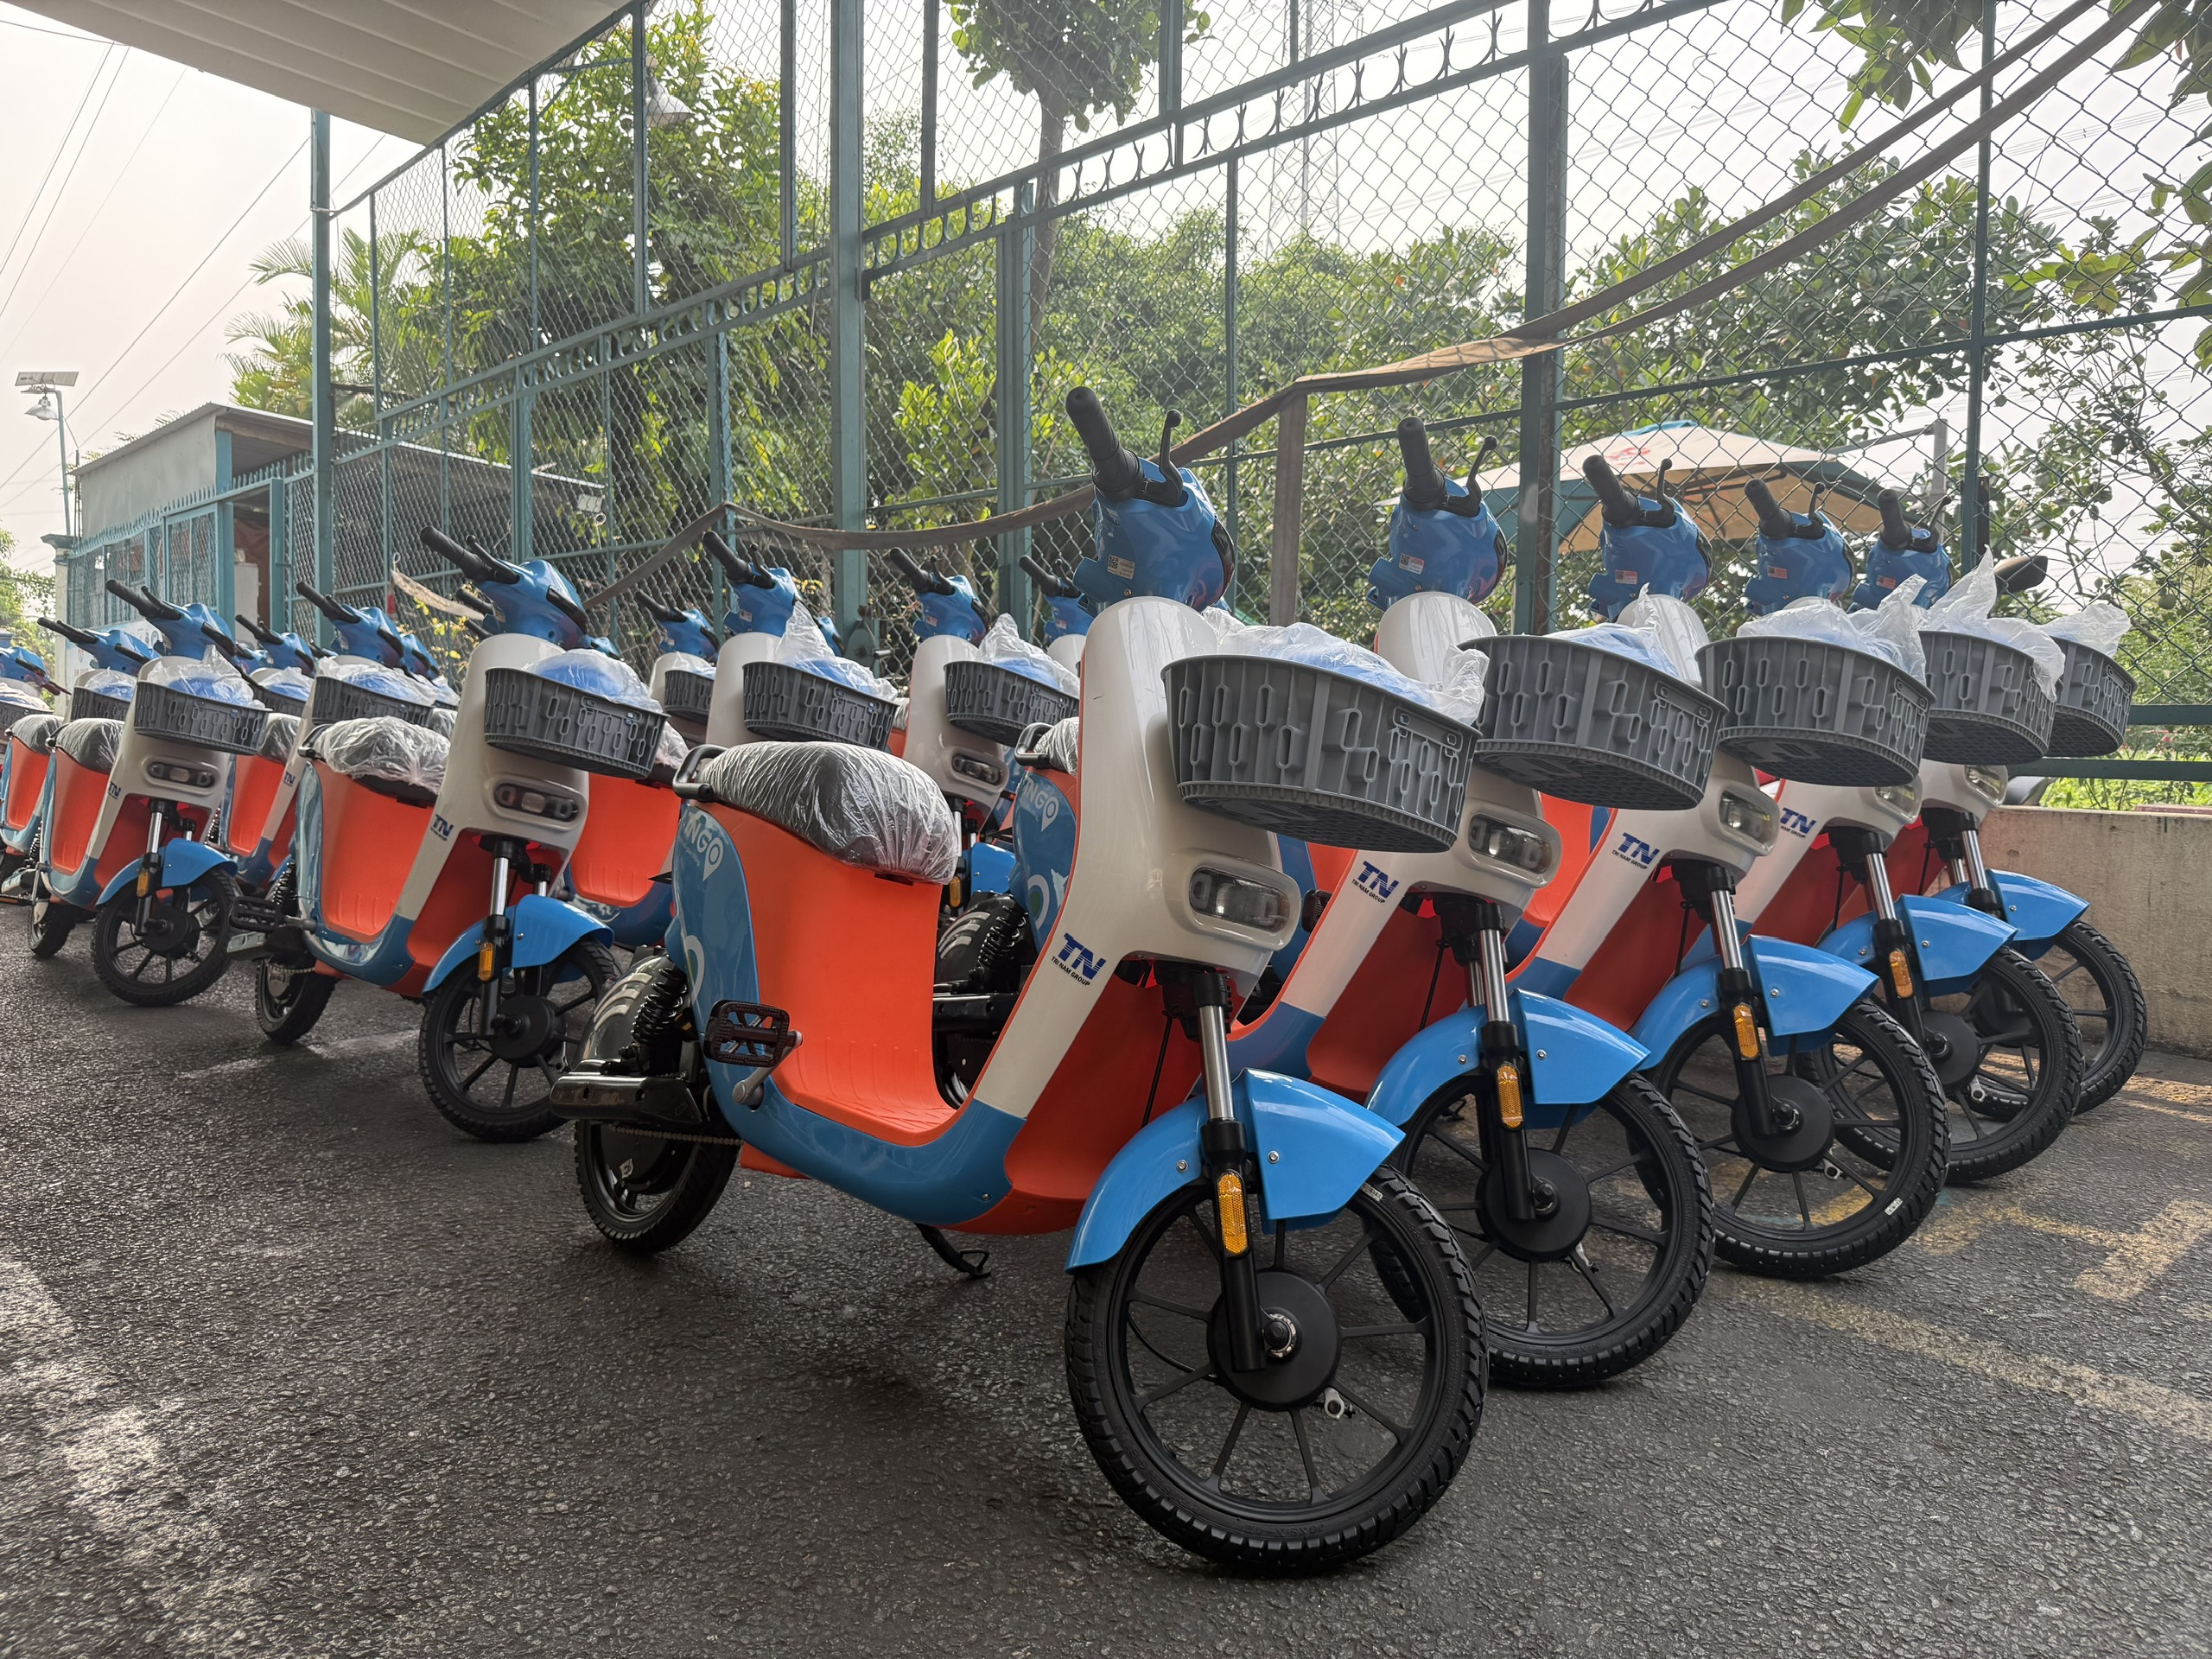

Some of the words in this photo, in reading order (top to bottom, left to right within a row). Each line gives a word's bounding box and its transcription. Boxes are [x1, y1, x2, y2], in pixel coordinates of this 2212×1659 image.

[433, 814, 454, 836] TN
[1780, 807, 1816, 834] TN
[1618, 832, 1660, 865] TN
[1619, 853, 1631, 861] NAM
[1630, 859, 1648, 869] GROUP
[1357, 861, 1400, 899] TN
[1358, 884, 1370, 894] NAM
[1369, 892, 1386, 904] GROUP
[1058, 932, 1106, 980] TN
[1052, 956, 1060, 965] TRI
[1059, 962, 1071, 975] NAM
[1071, 971, 1090, 986] GROUP
